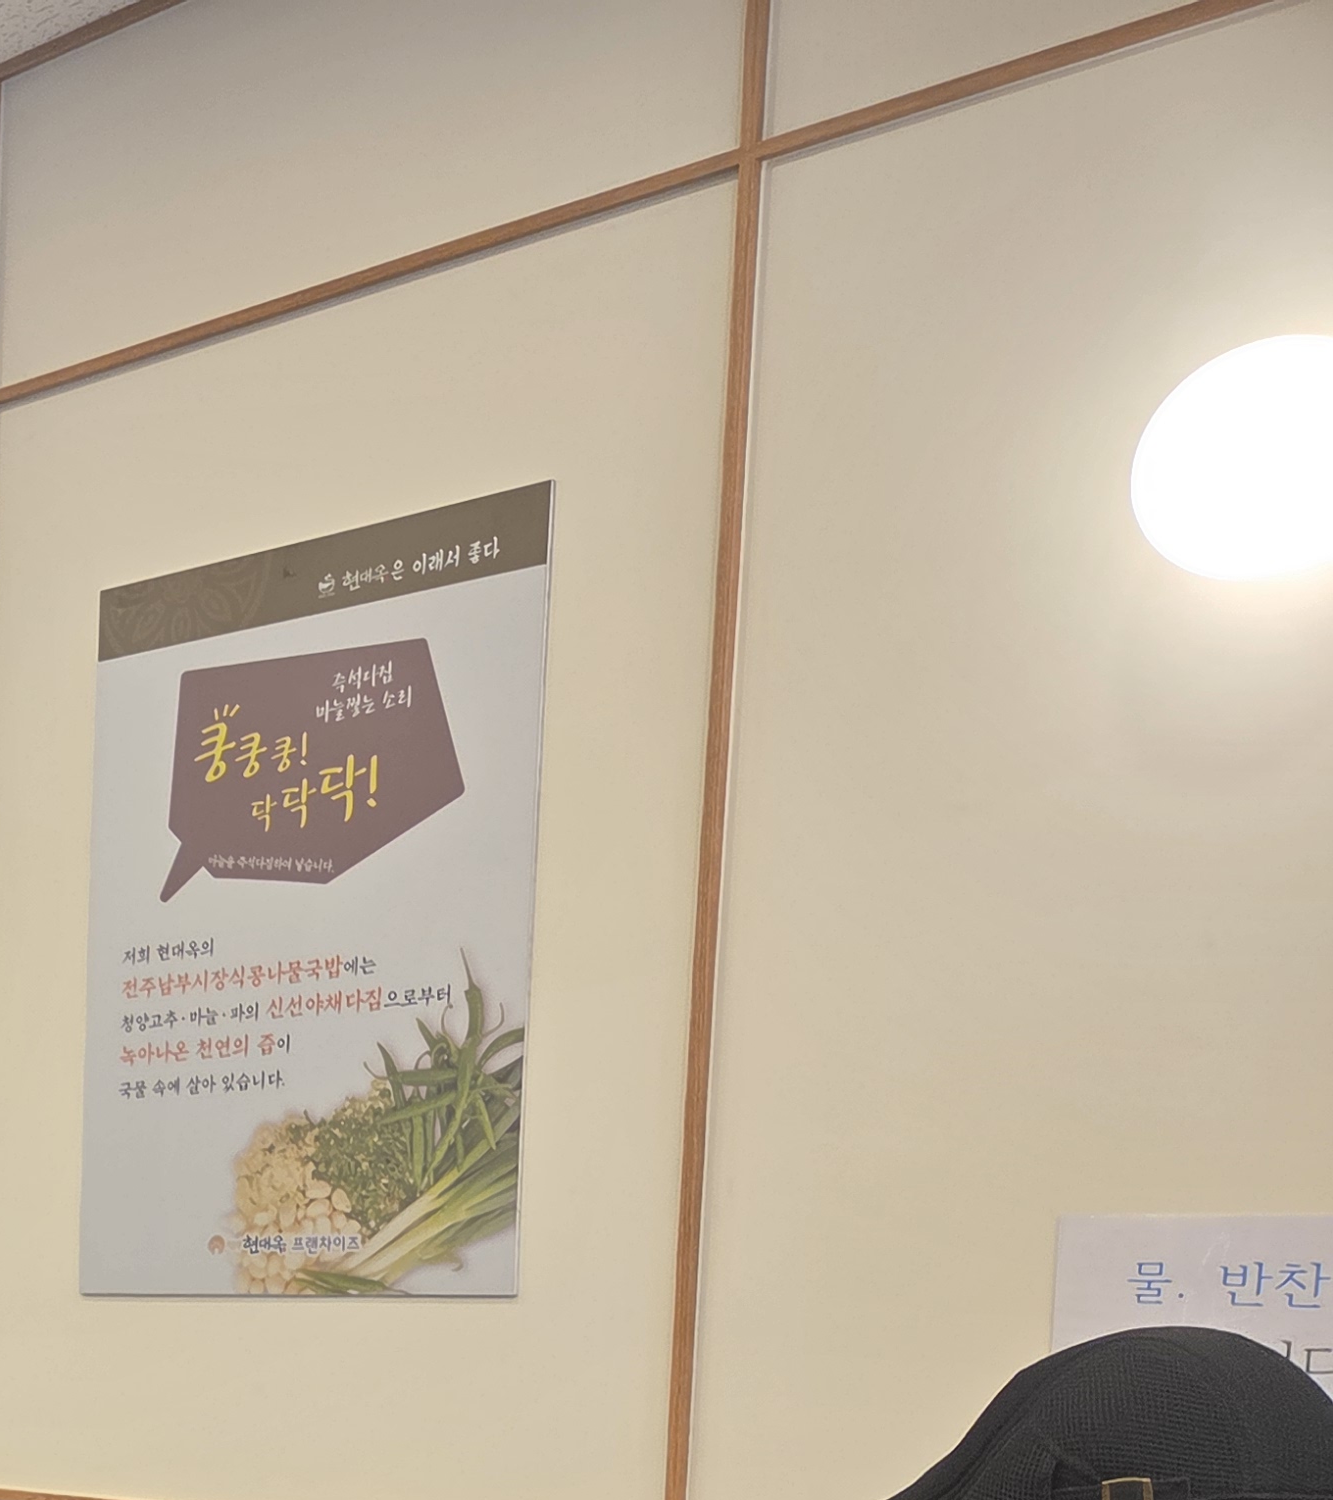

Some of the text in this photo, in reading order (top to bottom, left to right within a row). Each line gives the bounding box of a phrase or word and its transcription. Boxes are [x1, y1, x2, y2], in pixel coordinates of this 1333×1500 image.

[412, 544, 461, 575] 이래서
[467, 535, 500, 564] 좋다
[382, 684, 412, 709] 소리
[122, 937, 214, 965] 저희 현대옥의
[120, 1032, 290, 1066] 녹아나온 천연의 즙이
[118, 1069, 285, 1099] 국물 속에 살아 있습니다.
[243, 1234, 287, 1255] 현대옥
[1219, 1261, 1332, 1309] 반찬
